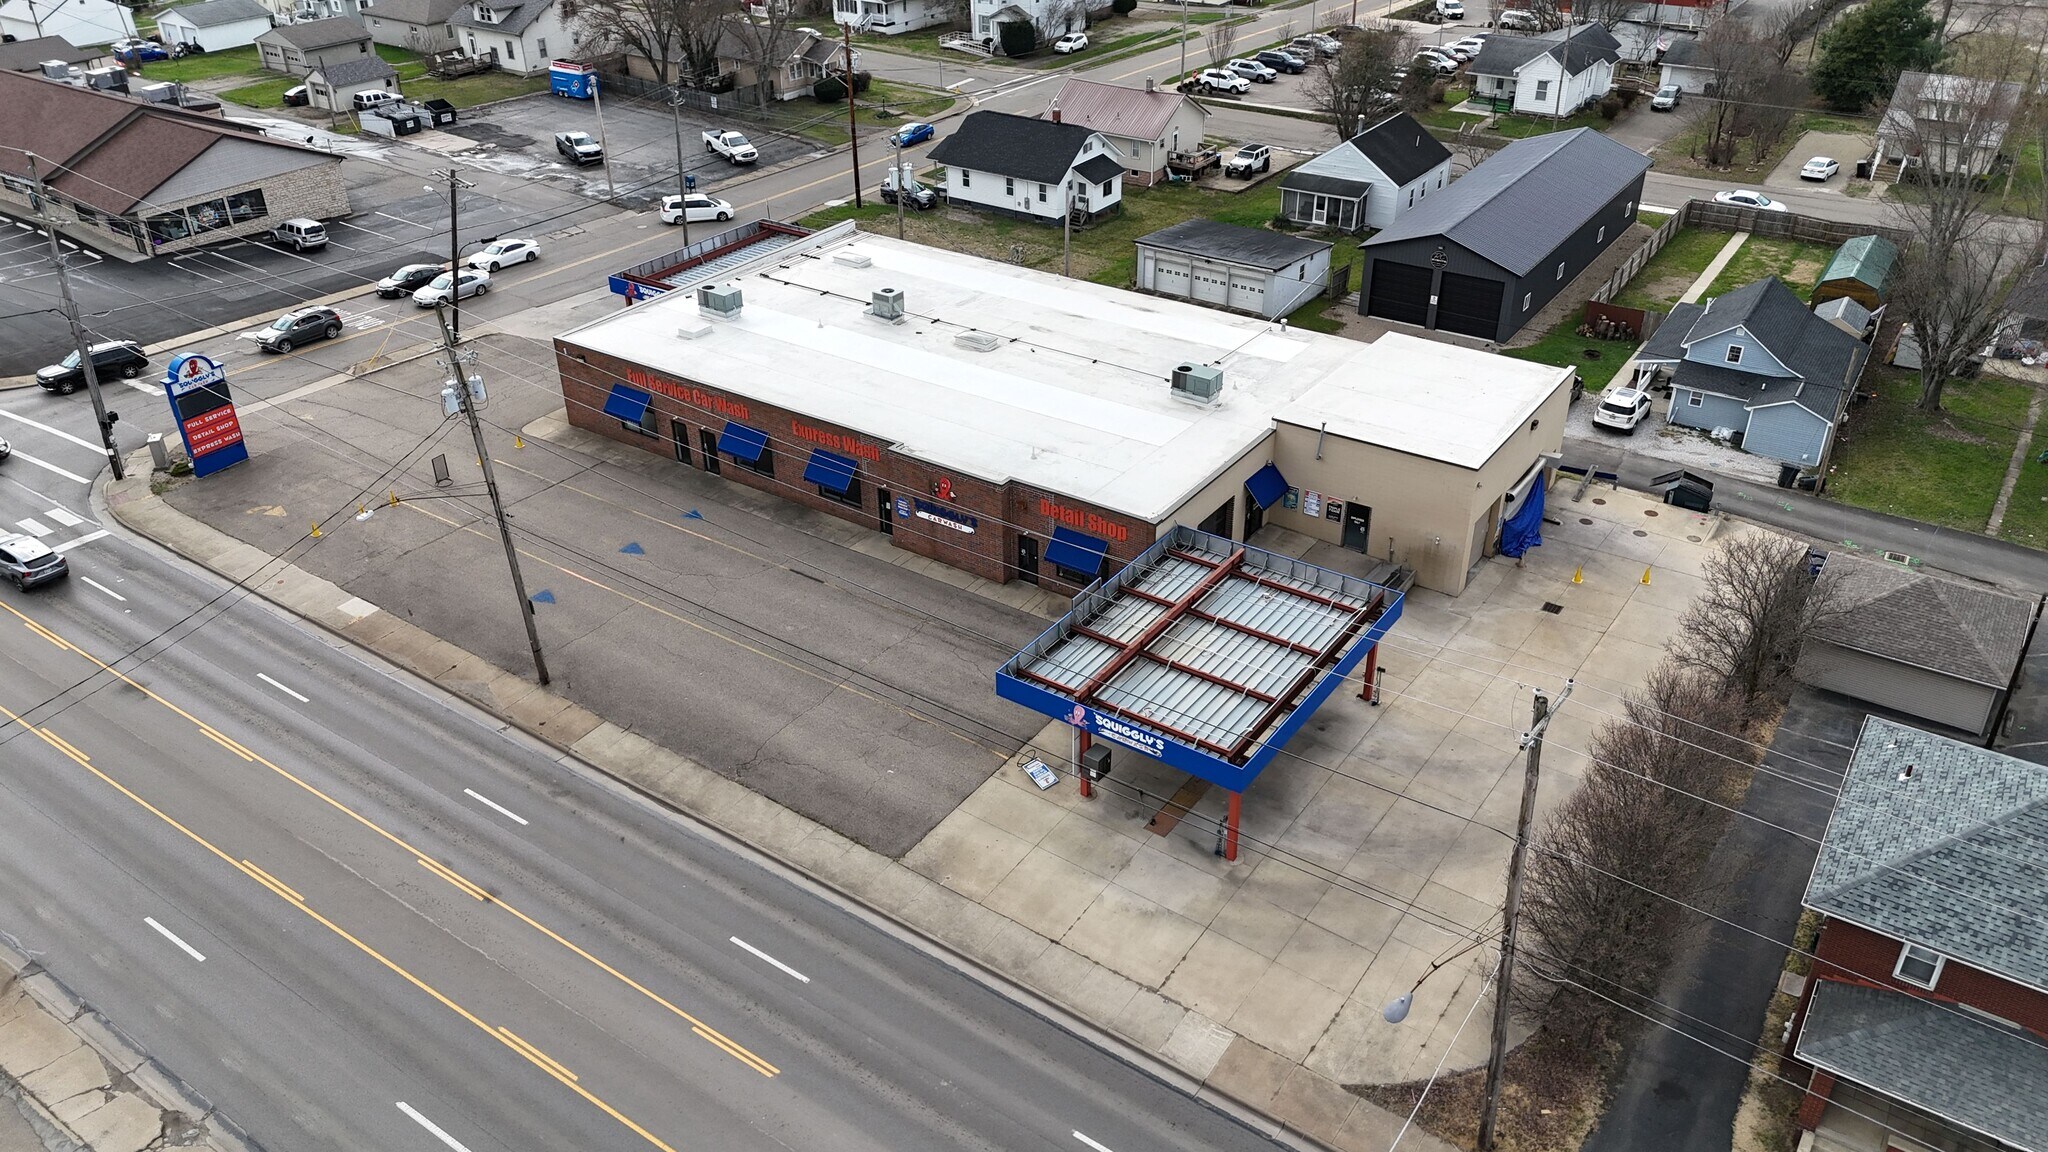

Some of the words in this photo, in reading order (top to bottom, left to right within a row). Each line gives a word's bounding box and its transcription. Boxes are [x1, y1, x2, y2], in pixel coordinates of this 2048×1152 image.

[626, 367, 647, 387] Full
[647, 374, 691, 401] Service
[692, 389, 713, 410] Car
[713, 395, 750, 420] Wash
[187, 419, 204, 429] FULL
[204, 408, 231, 423] SERVICE
[192, 429, 215, 441] DETAIL
[216, 421, 234, 432] SHOP
[193, 438, 222, 454] EXPRESS
[224, 432, 241, 442] WASH
[791, 418, 840, 449] Express
[842, 436, 880, 462] Wash
[927, 514, 964, 530] CARWASH
[1040, 498, 1085, 528] Detail
[1088, 512, 1127, 542] Shop
[1093, 711, 1165, 750] SQUIGGLY'S
